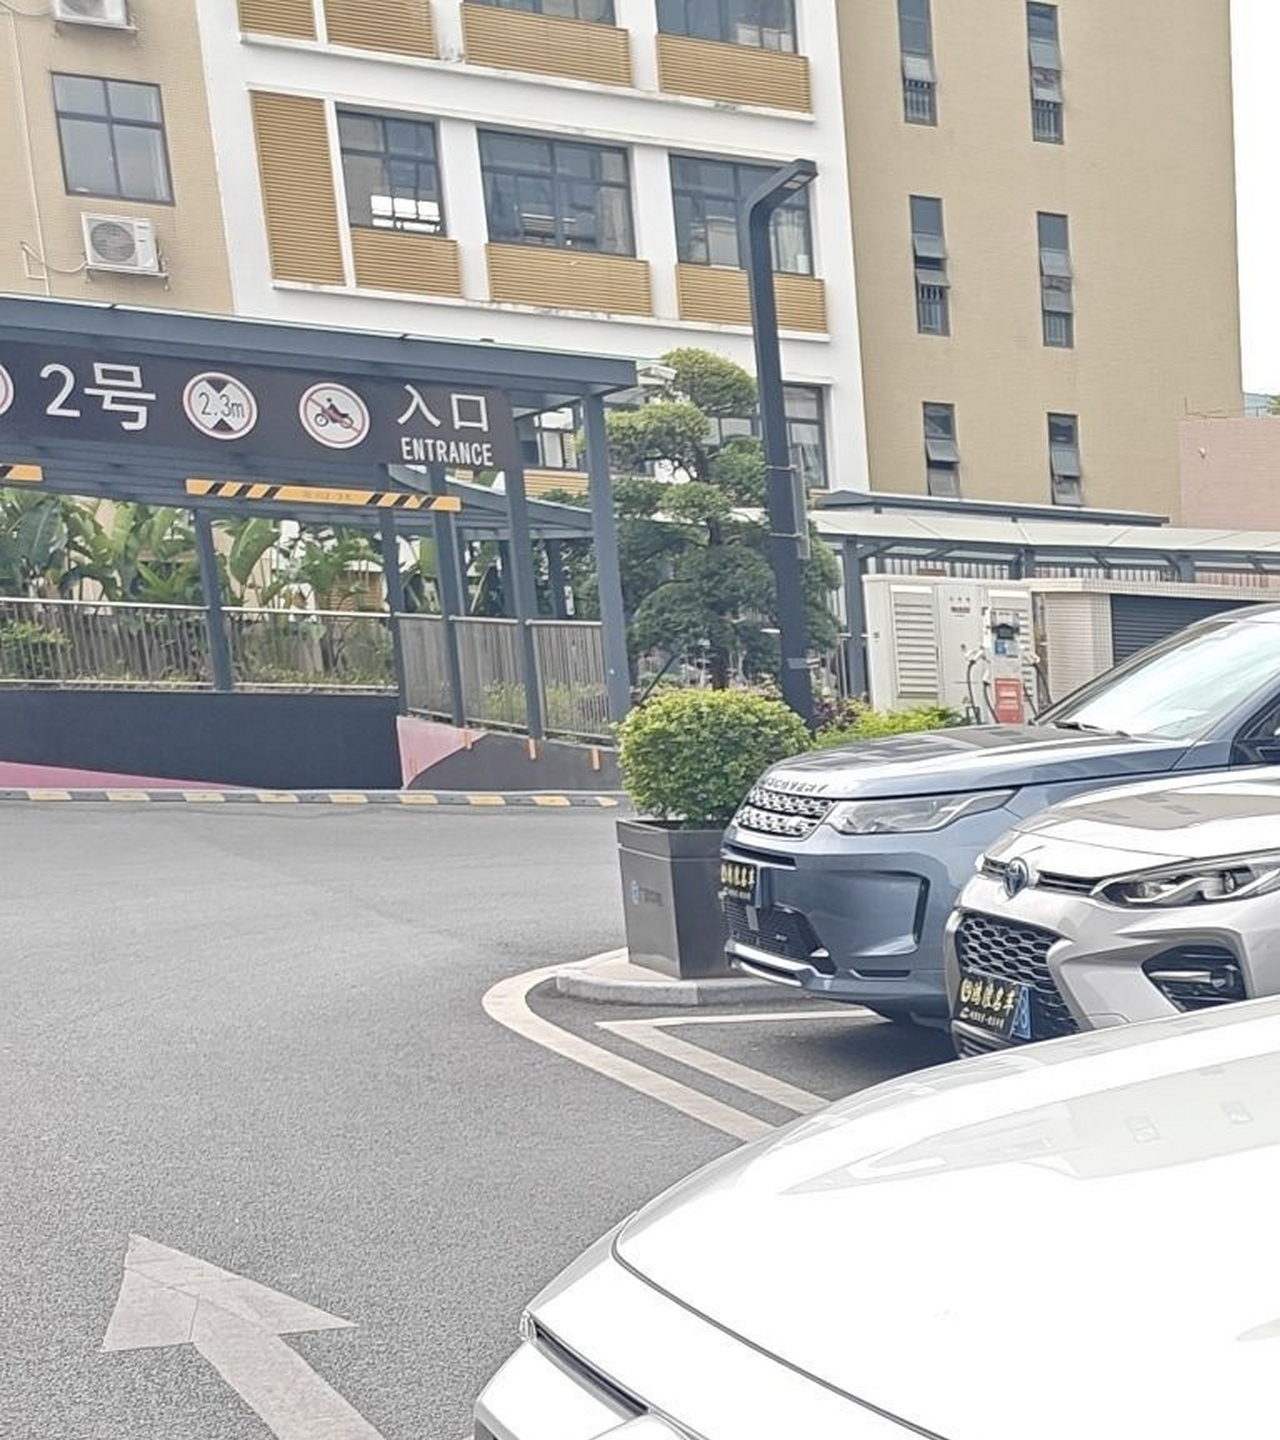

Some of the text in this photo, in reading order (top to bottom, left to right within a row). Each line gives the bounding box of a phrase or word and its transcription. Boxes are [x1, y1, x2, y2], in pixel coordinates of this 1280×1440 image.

[40, 362, 156, 430] 2号
[198, 391, 246, 419] 2.3m
[397, 383, 490, 432] 入口
[401, 436, 494, 467] ENTRANCE
